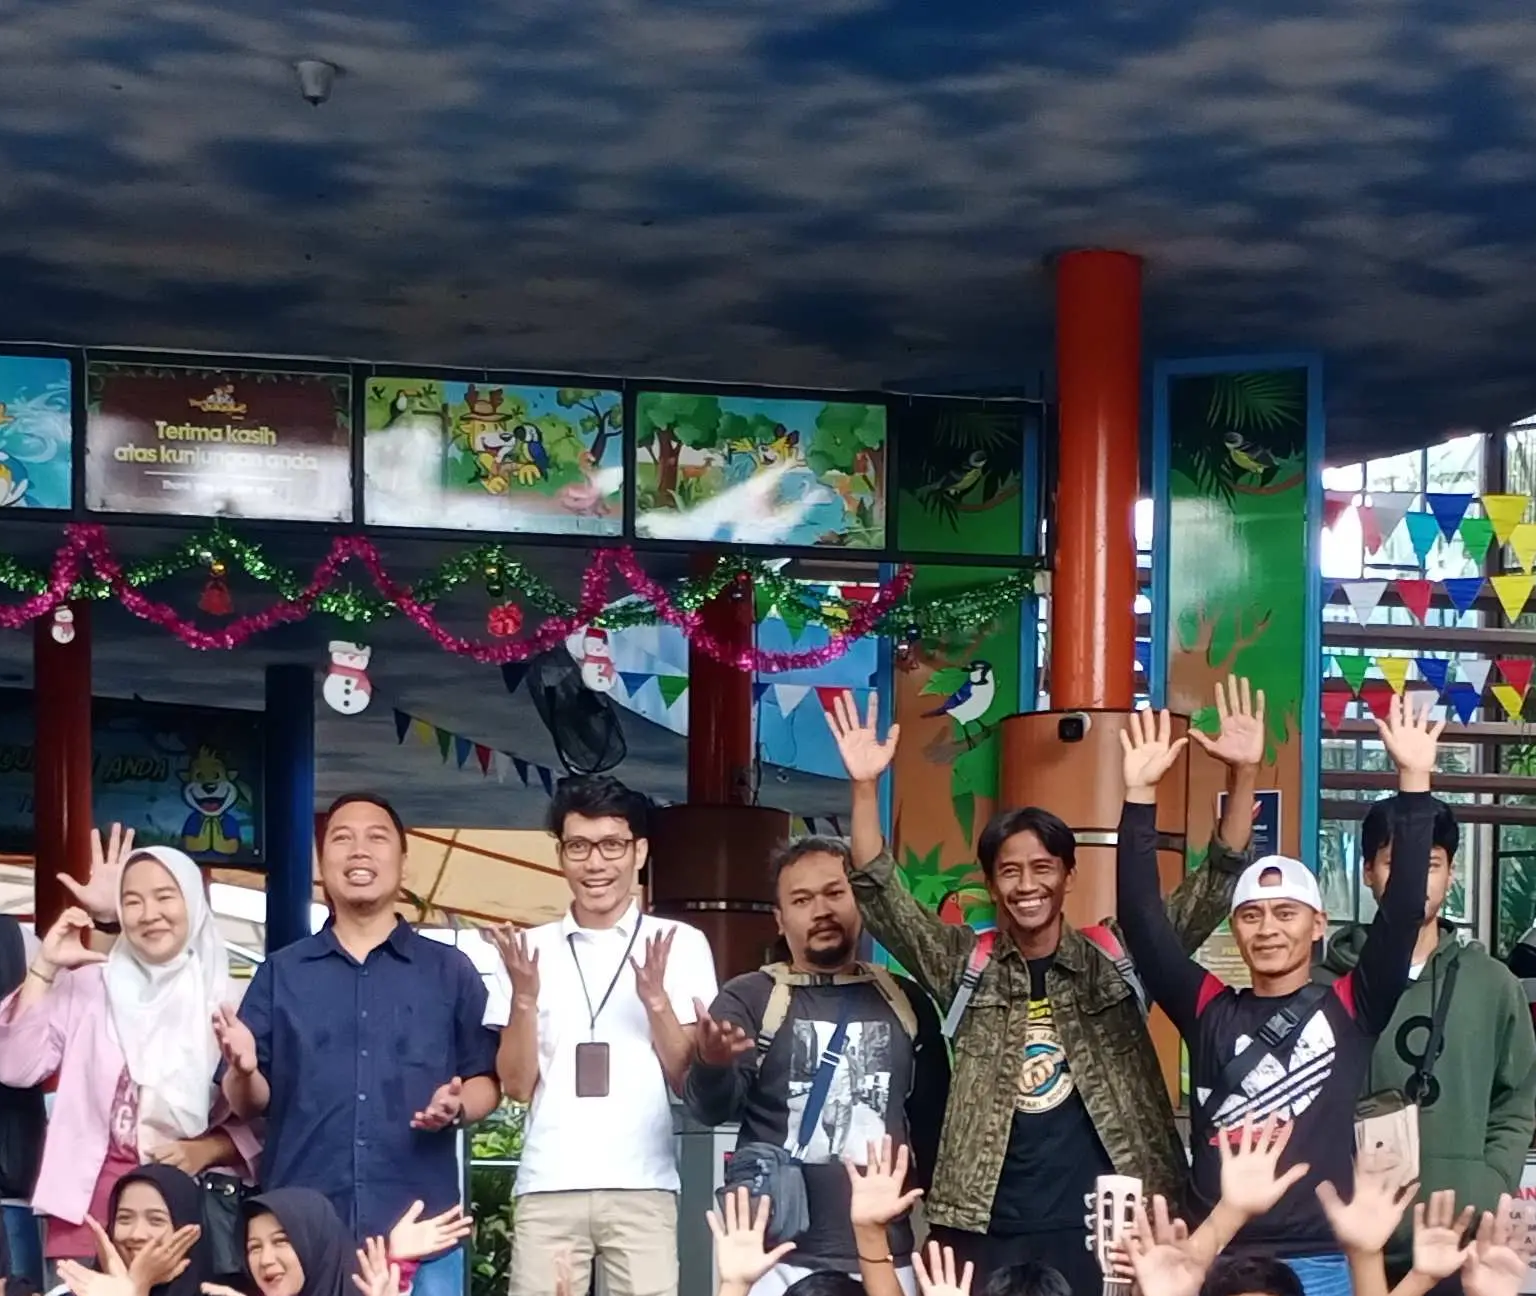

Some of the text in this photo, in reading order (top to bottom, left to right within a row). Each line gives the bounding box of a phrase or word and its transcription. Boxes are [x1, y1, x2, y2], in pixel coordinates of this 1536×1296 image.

[155, 421, 276, 446] Terima kasih
[114, 443, 157, 463] atas
[267, 453, 318, 470] anda
[104, 752, 169, 782] ANDA
